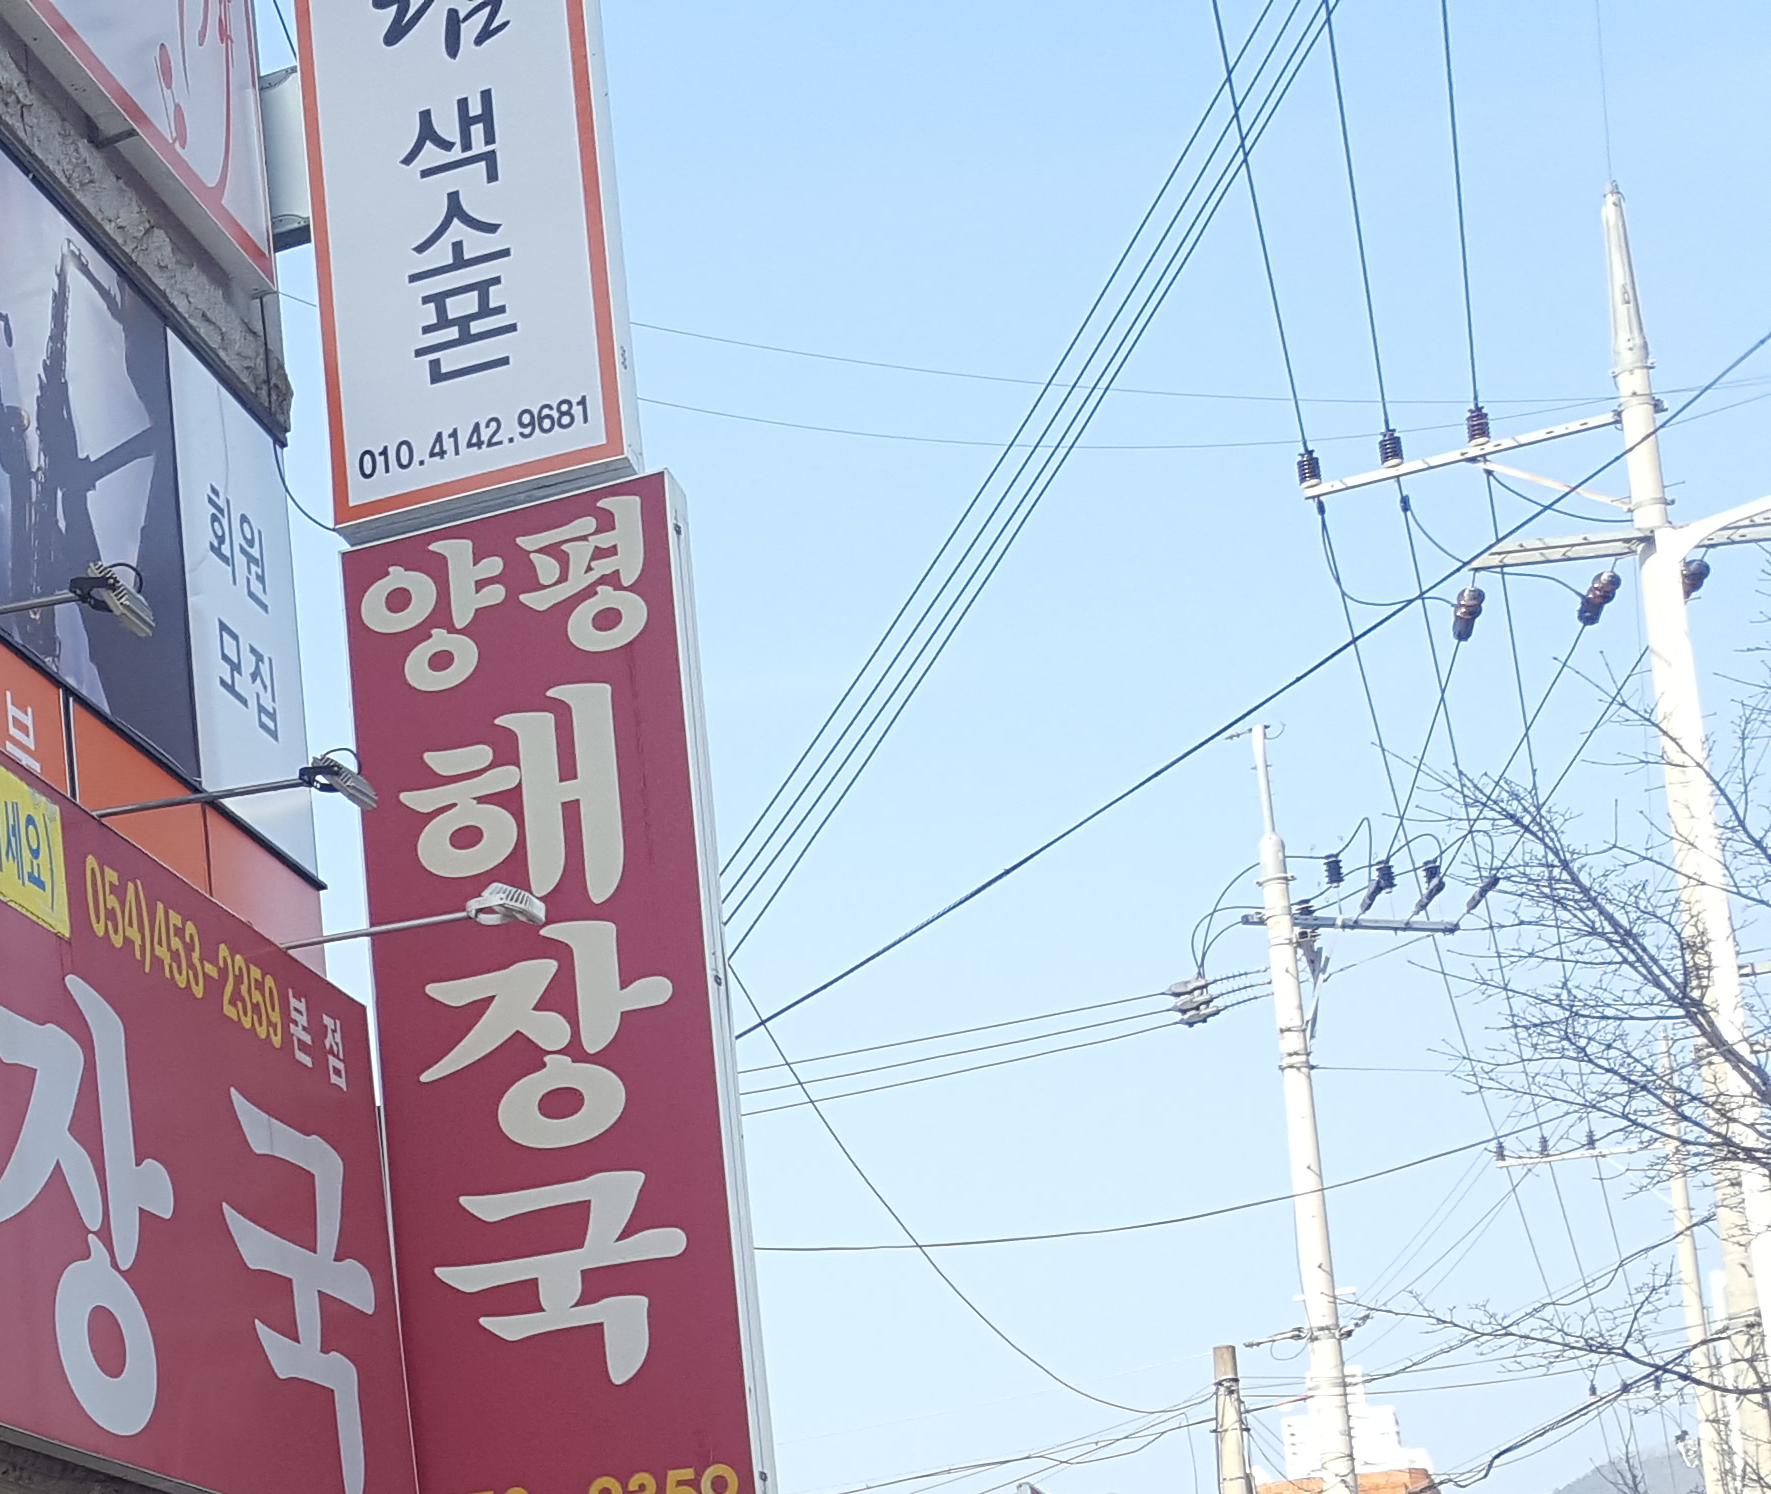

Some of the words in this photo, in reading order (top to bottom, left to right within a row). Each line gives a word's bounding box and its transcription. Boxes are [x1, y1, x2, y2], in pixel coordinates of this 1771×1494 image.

[398, 87, 519, 386] 색소폰
[358, 394, 591, 480] 010.4142.9681
[206, 481, 270, 615] 회원
[359, 494, 649, 693] 양평
[216, 616, 279, 745] 모집
[83, 853, 282, 1049] 054)453-2359
[287, 987, 348, 1093] 본점
[398, 681, 689, 1387] 해장국
